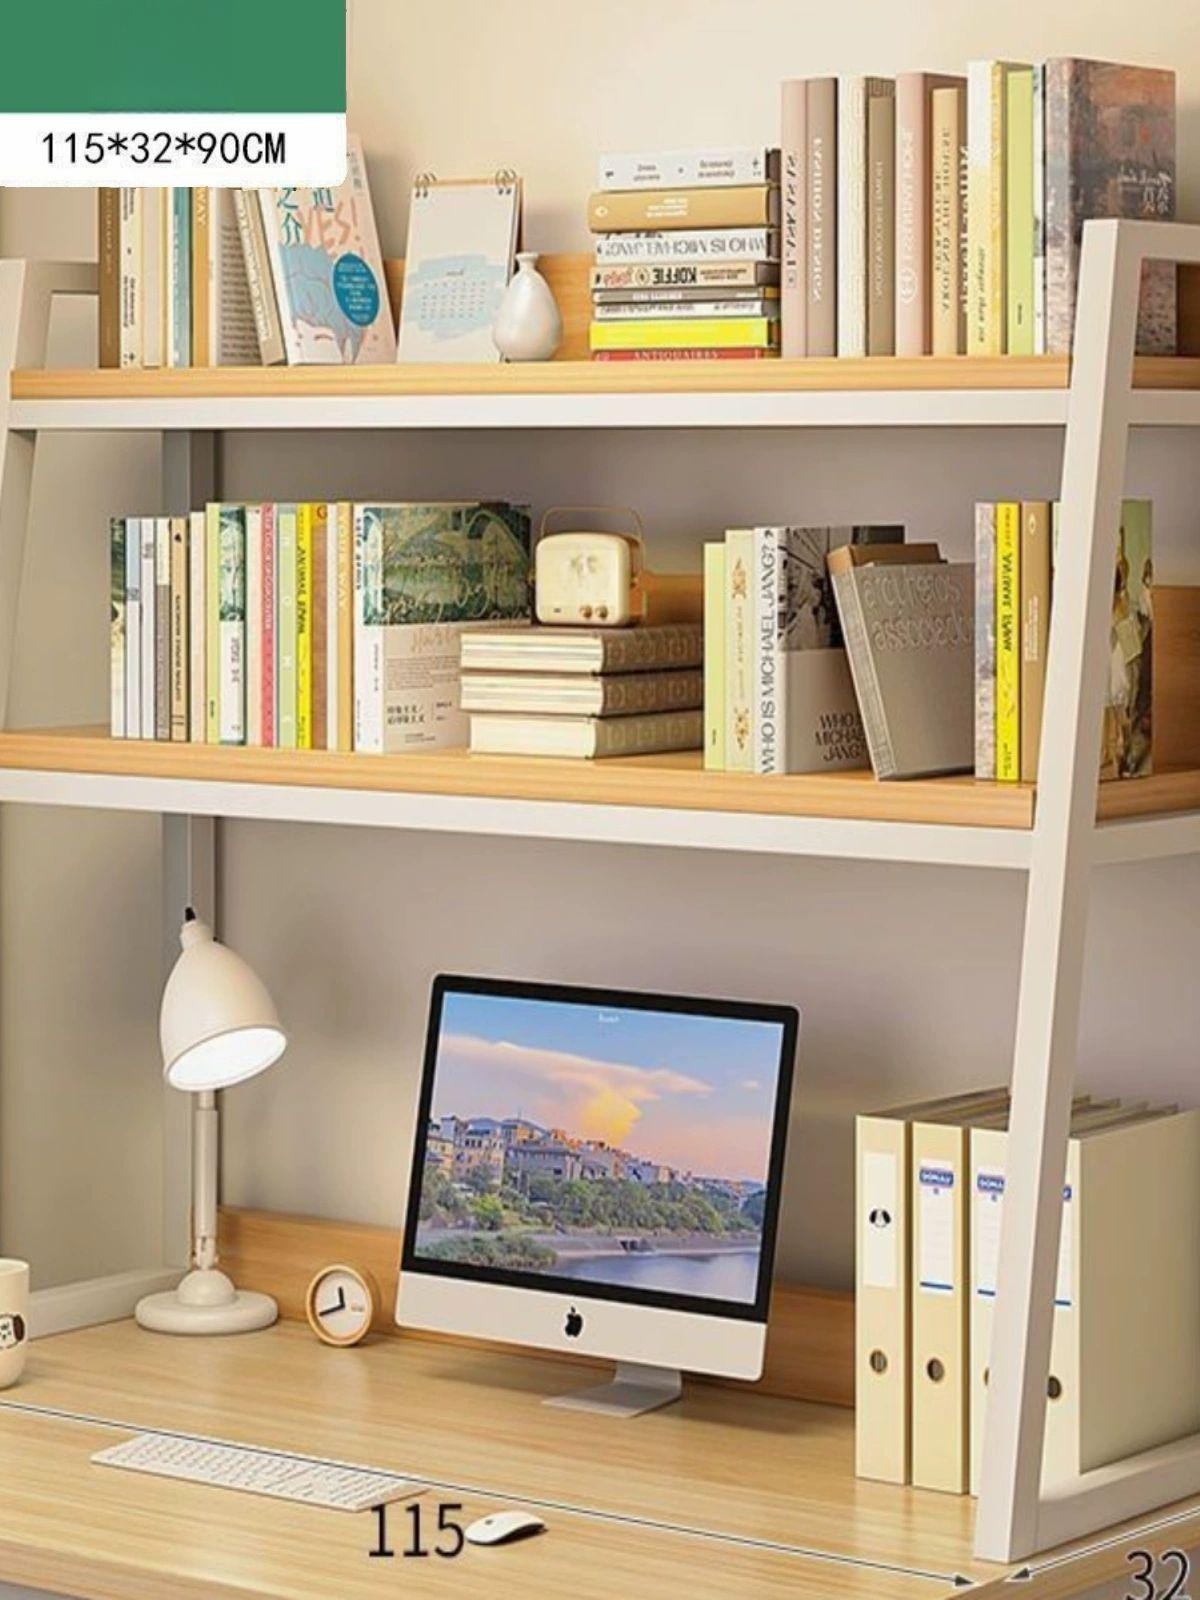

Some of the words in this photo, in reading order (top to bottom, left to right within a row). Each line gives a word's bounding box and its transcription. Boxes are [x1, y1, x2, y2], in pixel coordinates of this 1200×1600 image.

[652, 266, 698, 285] KOFFIE
[761, 544, 776, 607] JANG?
[761, 614, 776, 698] MICHAEL
[761, 700, 776, 719] IS
[761, 722, 776, 774] WHO
